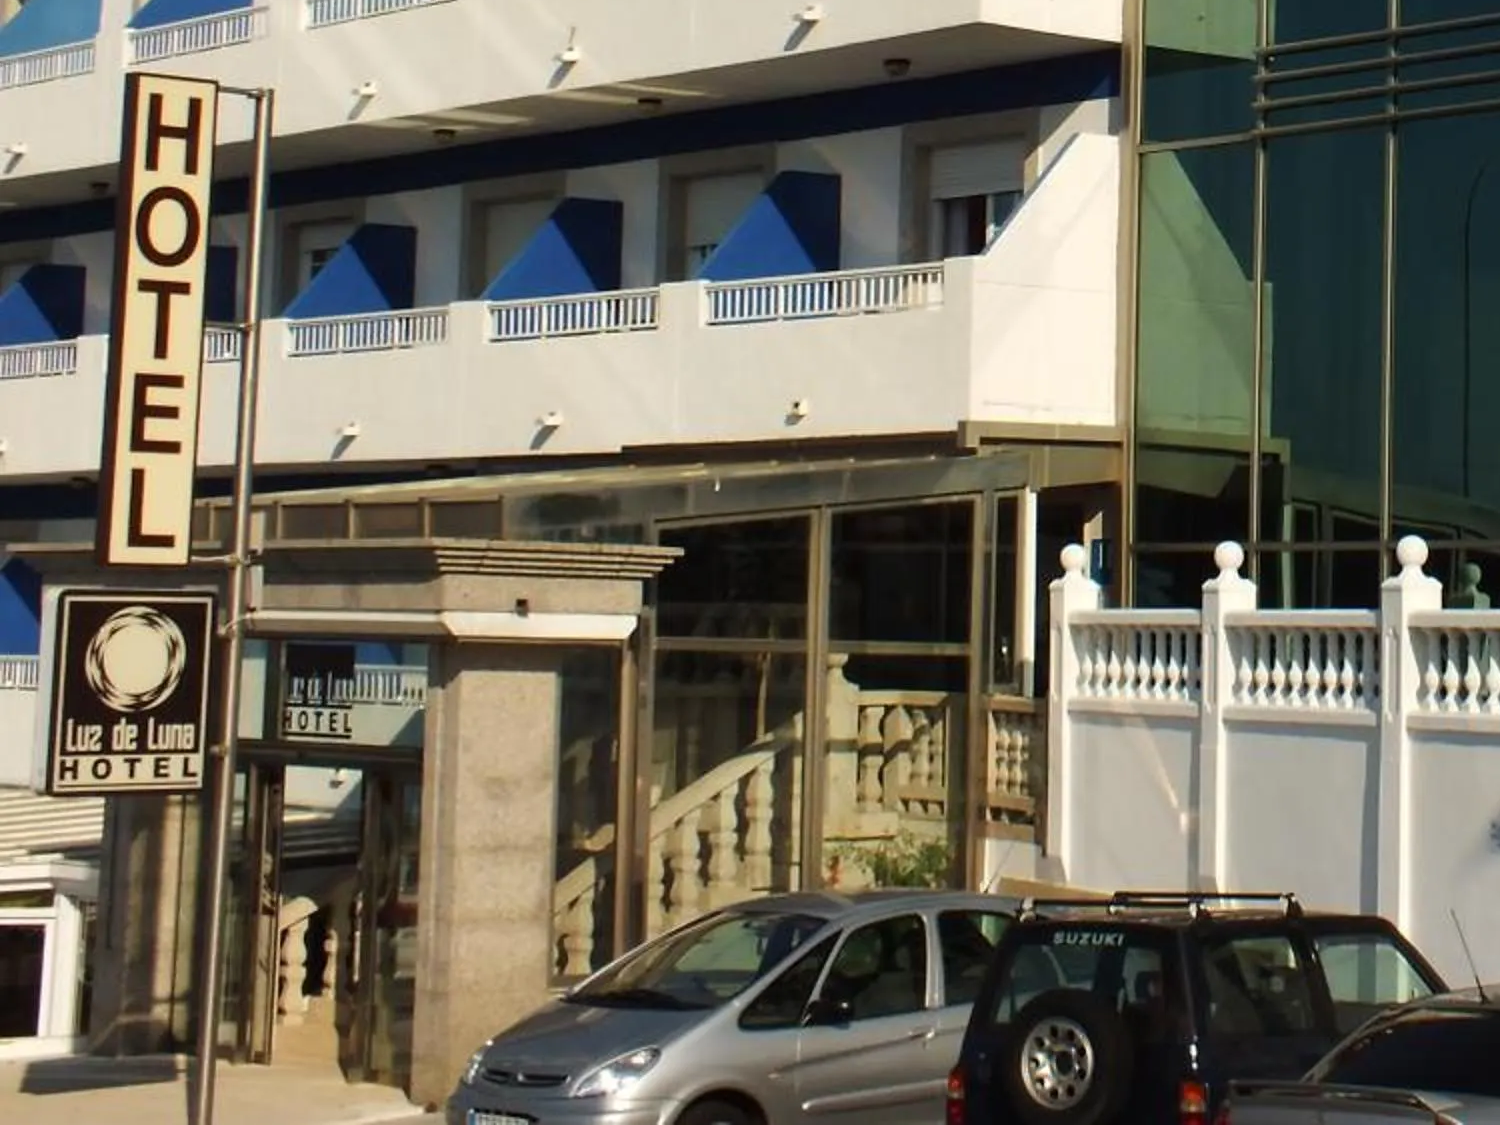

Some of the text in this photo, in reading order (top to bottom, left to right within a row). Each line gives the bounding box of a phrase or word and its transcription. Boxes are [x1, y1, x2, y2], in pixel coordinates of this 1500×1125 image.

[127, 92, 203, 548] HOTEL
[284, 709, 352, 733] HOTEL
[66, 716, 196, 751] Luz de Luna
[59, 757, 198, 780] HOTEL
[1053, 930, 1124, 947] SUZUKI
